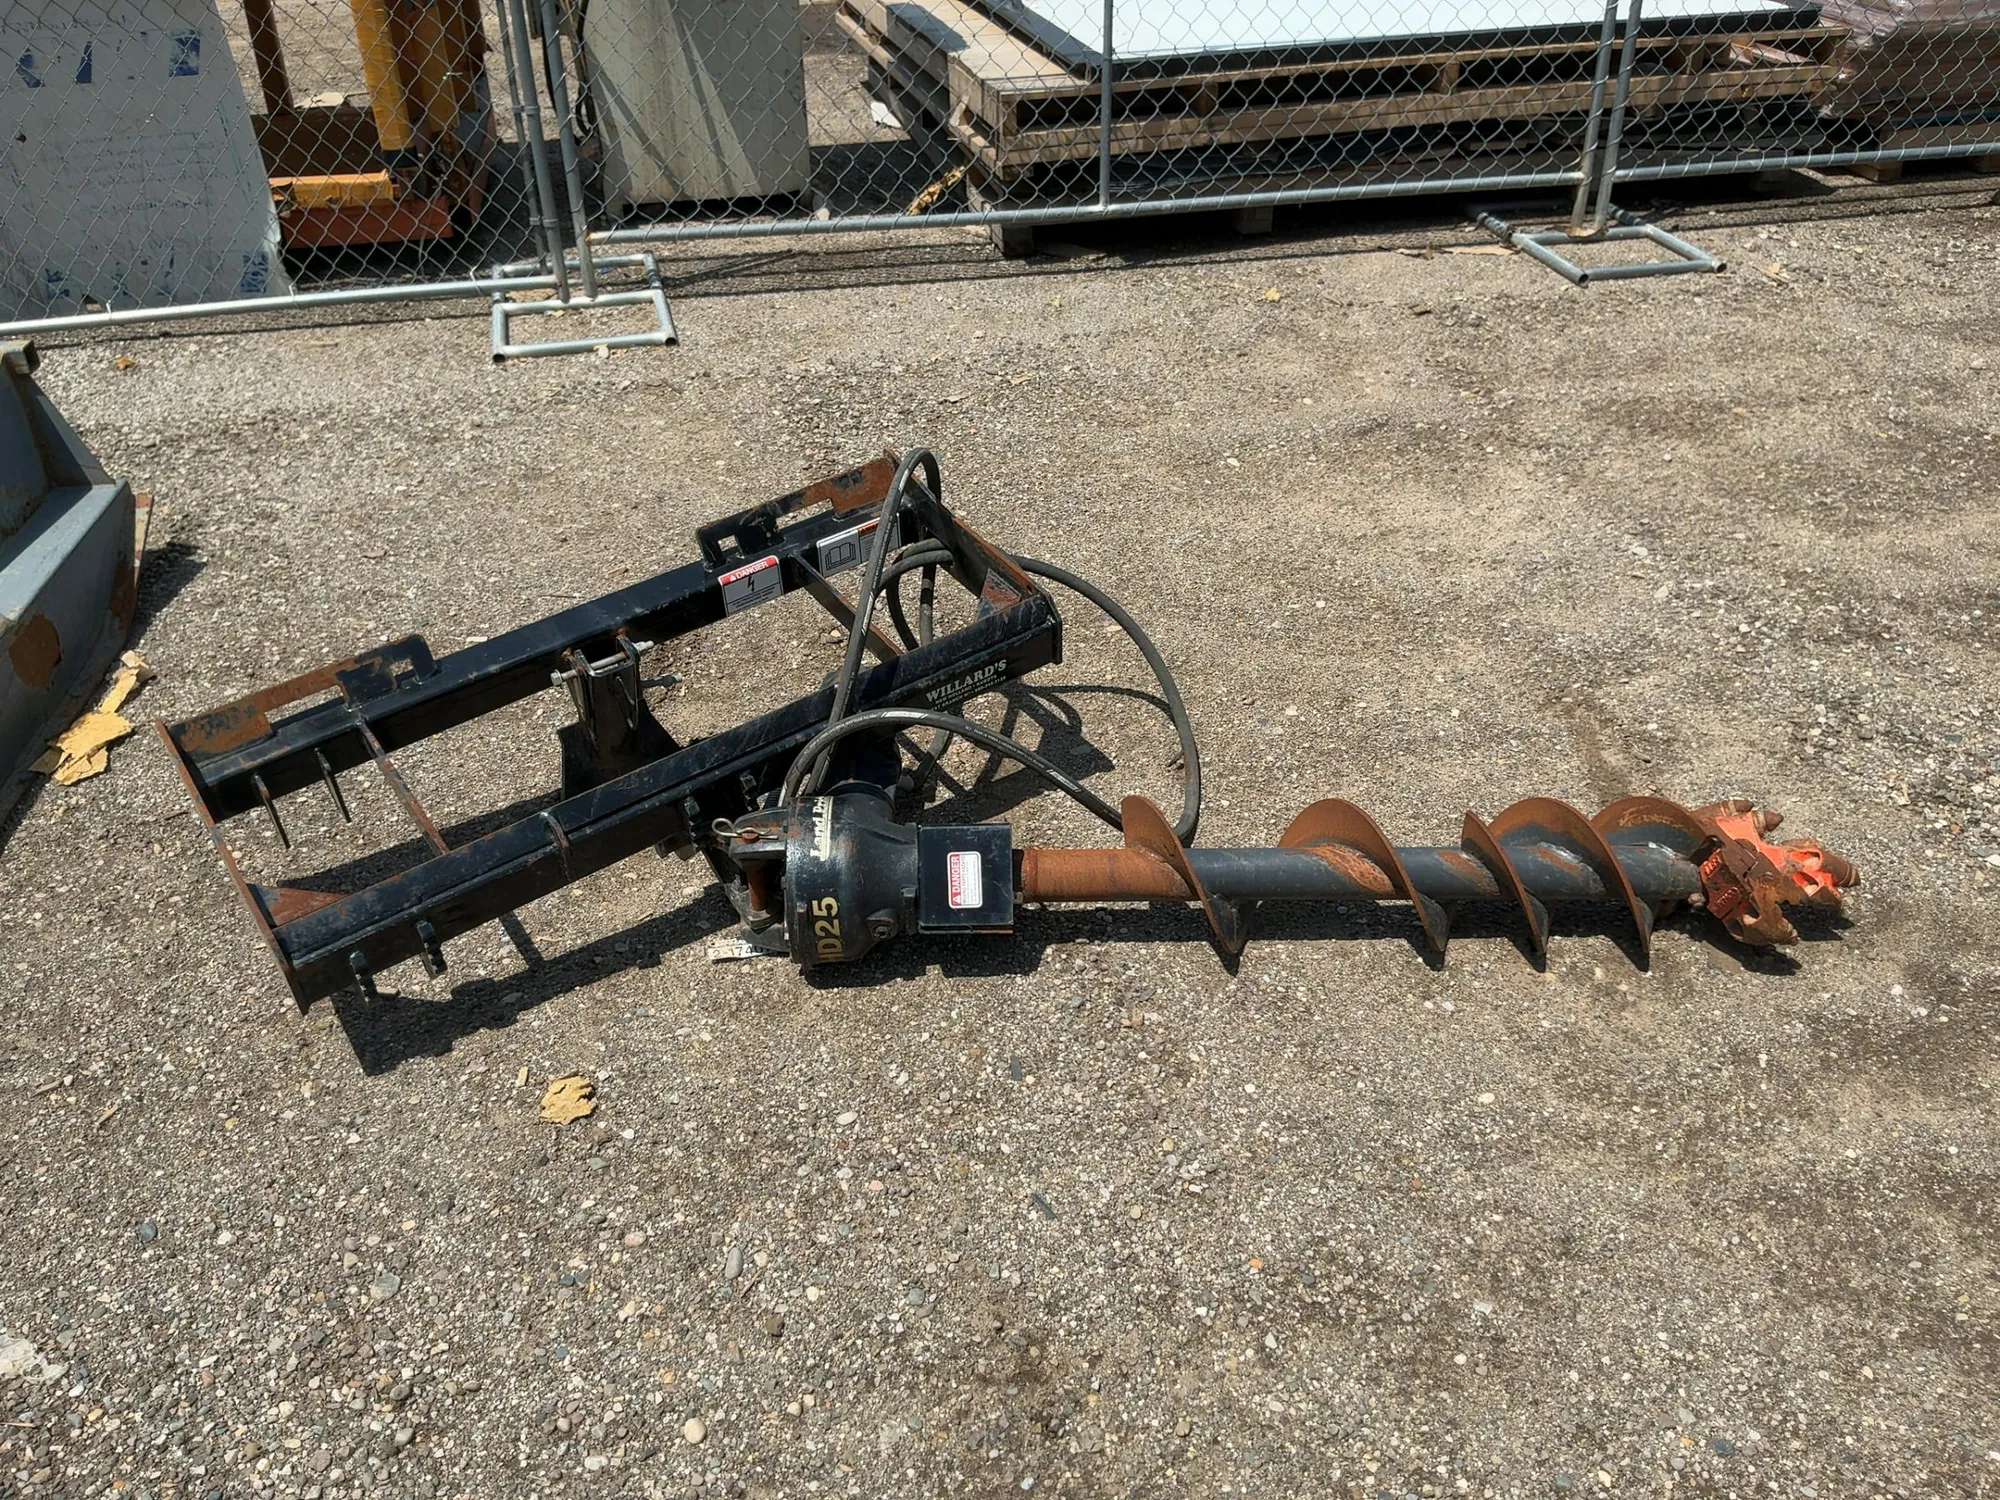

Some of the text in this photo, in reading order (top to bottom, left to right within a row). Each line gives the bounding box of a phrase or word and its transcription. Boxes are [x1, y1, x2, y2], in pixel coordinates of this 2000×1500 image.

[735, 562, 768, 579] DANGER
[926, 659, 1007, 702] WILLARD'S
[948, 685, 972, 699] HOLLAND
[810, 817, 827, 858] Land
[951, 856, 961, 893] DANGER
[812, 896, 844, 963] HD25
